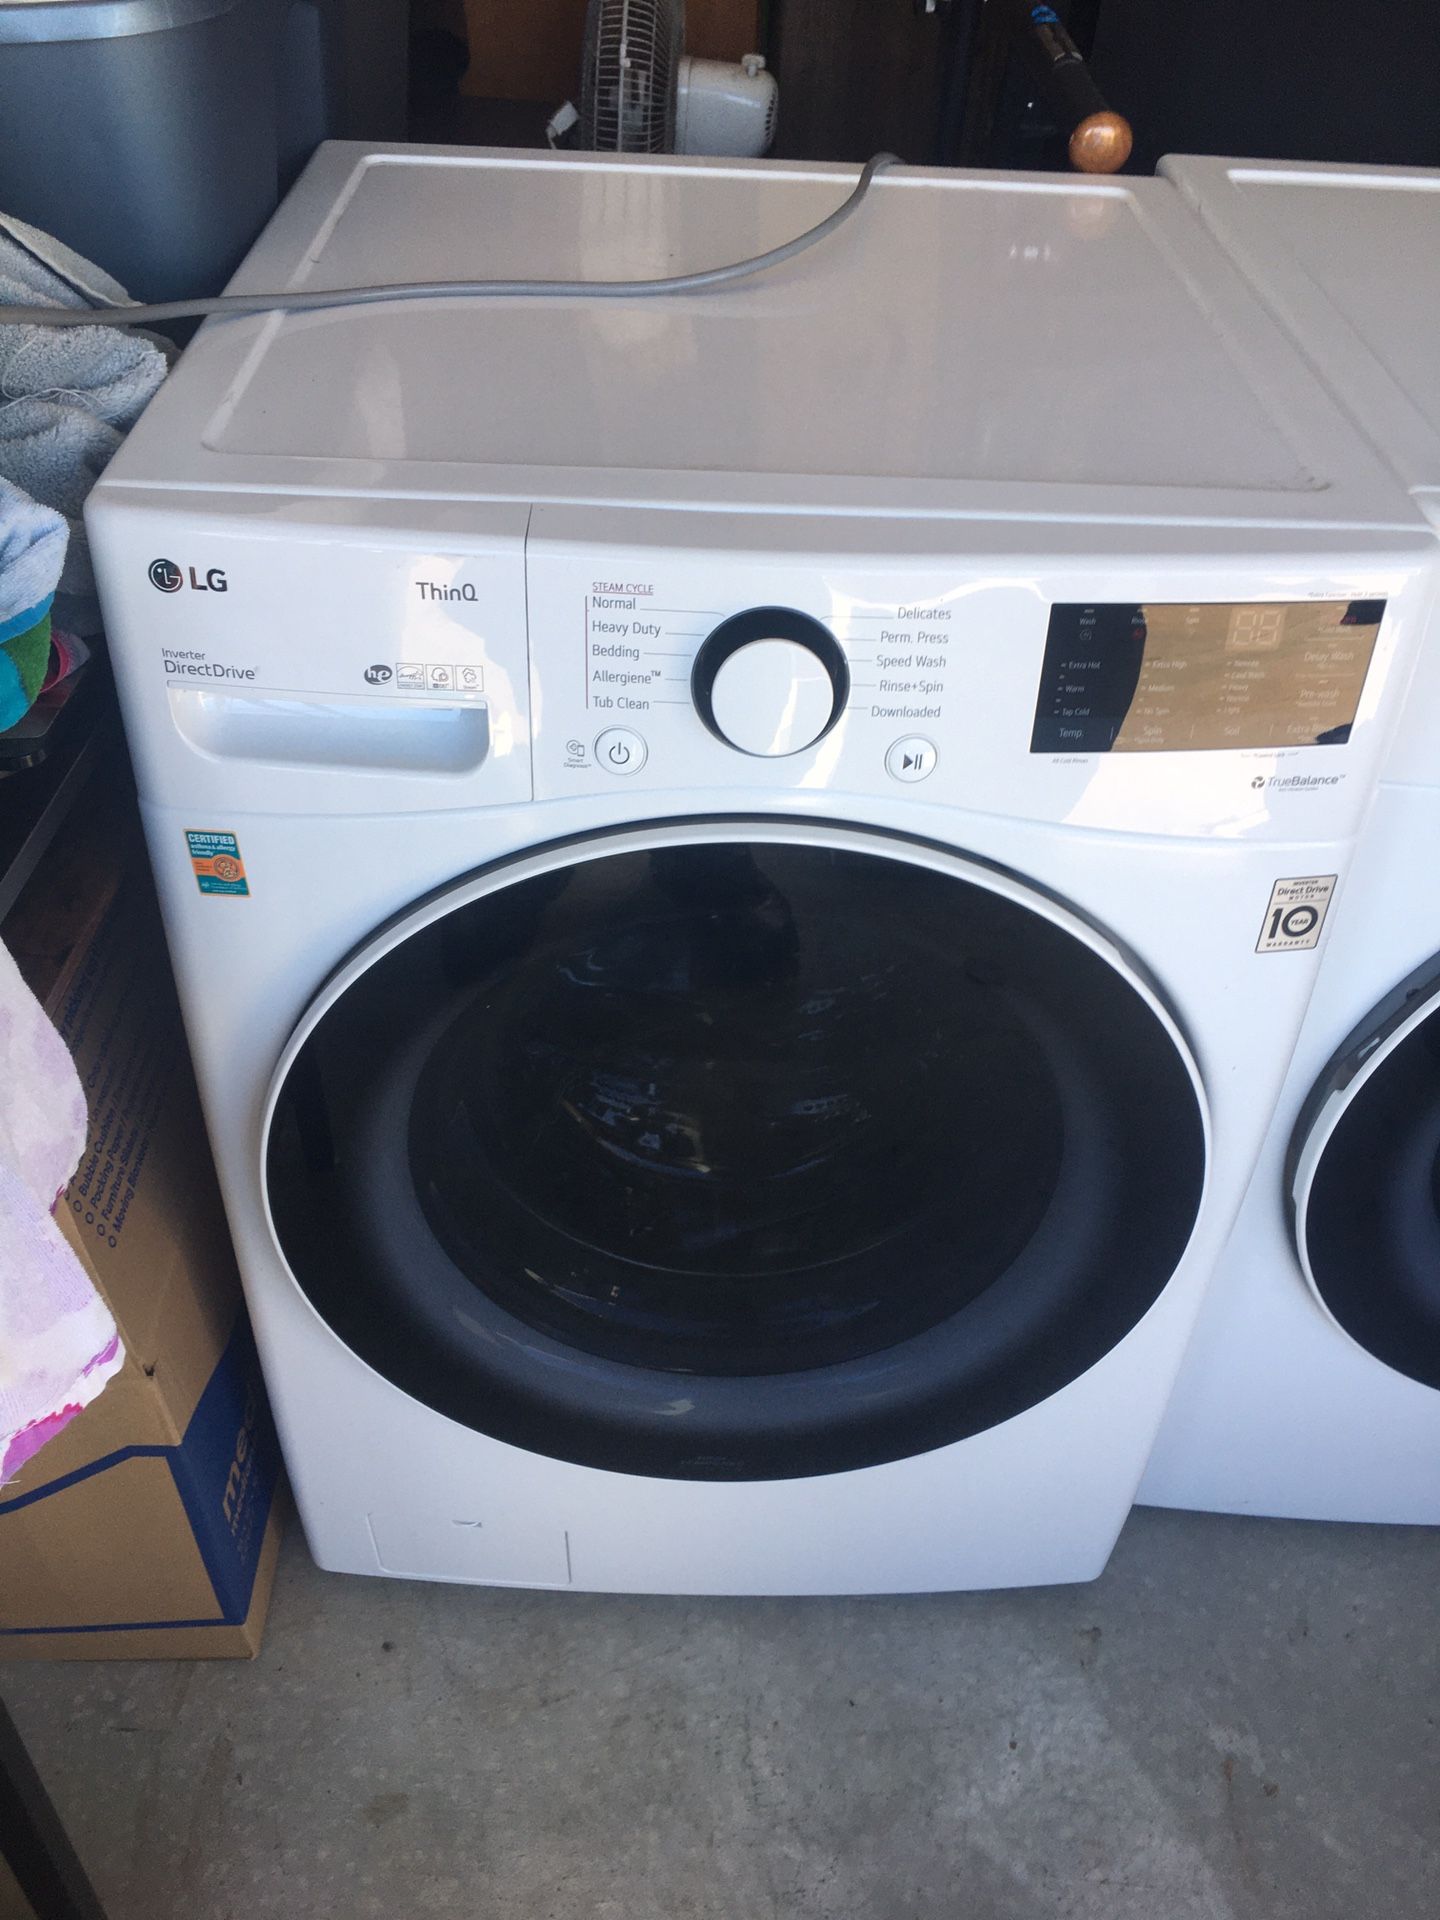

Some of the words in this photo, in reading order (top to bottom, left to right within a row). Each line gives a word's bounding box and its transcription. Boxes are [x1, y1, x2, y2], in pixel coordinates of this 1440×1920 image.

[188, 566, 228, 592] LG
[415, 581, 479, 601] ThinQ
[592, 582, 623, 592] STEAM
[626, 583, 654, 594] CYCLE
[592, 596, 636, 610] Normal
[897, 606, 952, 620] Delicates
[592, 619, 628, 637] Heavy
[632, 621, 662, 638] Duty
[880, 630, 913, 644] Perm.
[917, 631, 949, 644] Press
[162, 648, 205, 660] Inverter
[592, 643, 640, 661] Bedding
[876, 654, 912, 669] Speed
[916, 655, 947, 668] Wash
[1068, 660, 1087, 670] Extra
[1088, 660, 1102, 670] Hot
[164, 659, 256, 680] DirectDrive
[879, 679, 944, 695] Rinse+Spin
[593, 696, 613, 708] Tub
[617, 697, 650, 710] Clean
[871, 705, 941, 718] Downloaded
[1059, 727, 1084, 739] Temp.
[188, 834, 234, 844] CERTIFIED
[1277, 886, 1304, 896] Direct
[1305, 885, 1330, 895] Drive
[1269, 906, 1318, 939] 10
[1291, 917, 1309, 926] YEAR
[79, 1154, 99, 1197] Bubble
[94, 1107, 116, 1154] Cushion
[90, 1160, 114, 1209] Packing
[107, 1124, 124, 1161] Paper
[101, 1166, 126, 1221] Furniture
[112, 1187, 135, 1233] Moving
